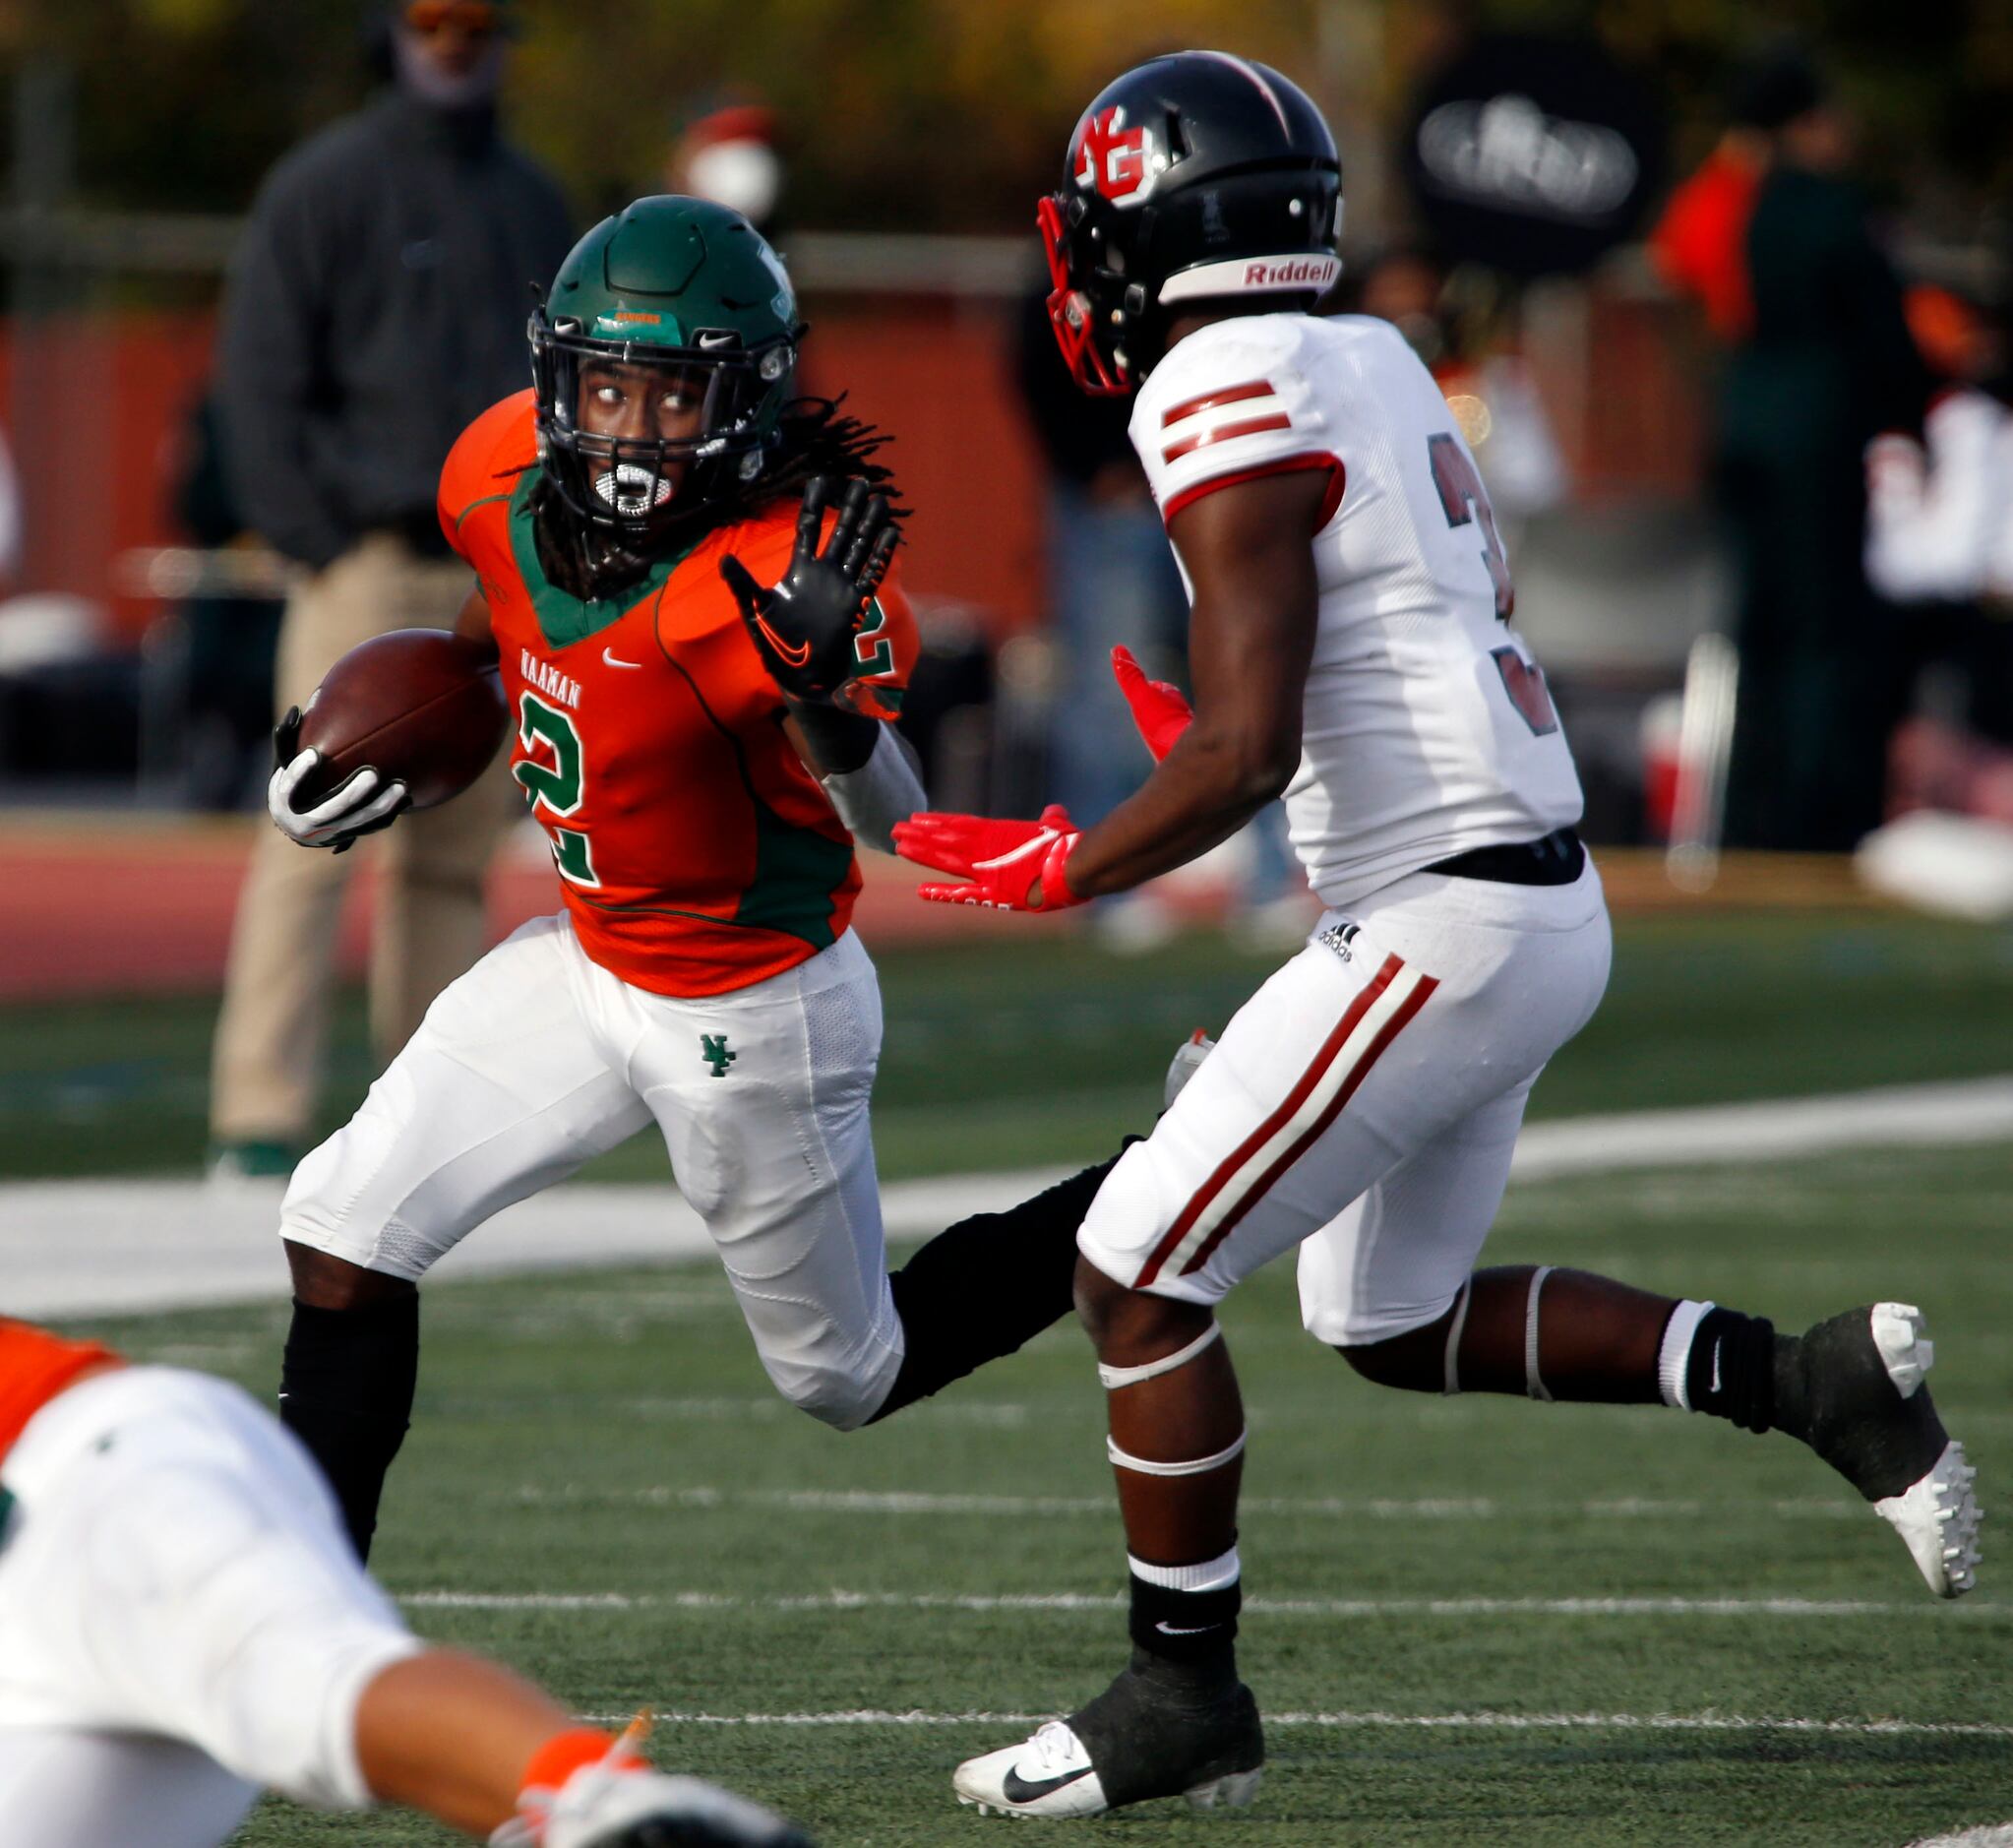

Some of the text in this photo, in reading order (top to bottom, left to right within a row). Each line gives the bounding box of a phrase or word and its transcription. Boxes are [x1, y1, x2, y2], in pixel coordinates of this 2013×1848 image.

[1244, 261, 1334, 286] Riddell
[520, 647, 581, 709] NAAMAN
[512, 689, 601, 888] 2
[1318, 930, 1353, 962] adidas
